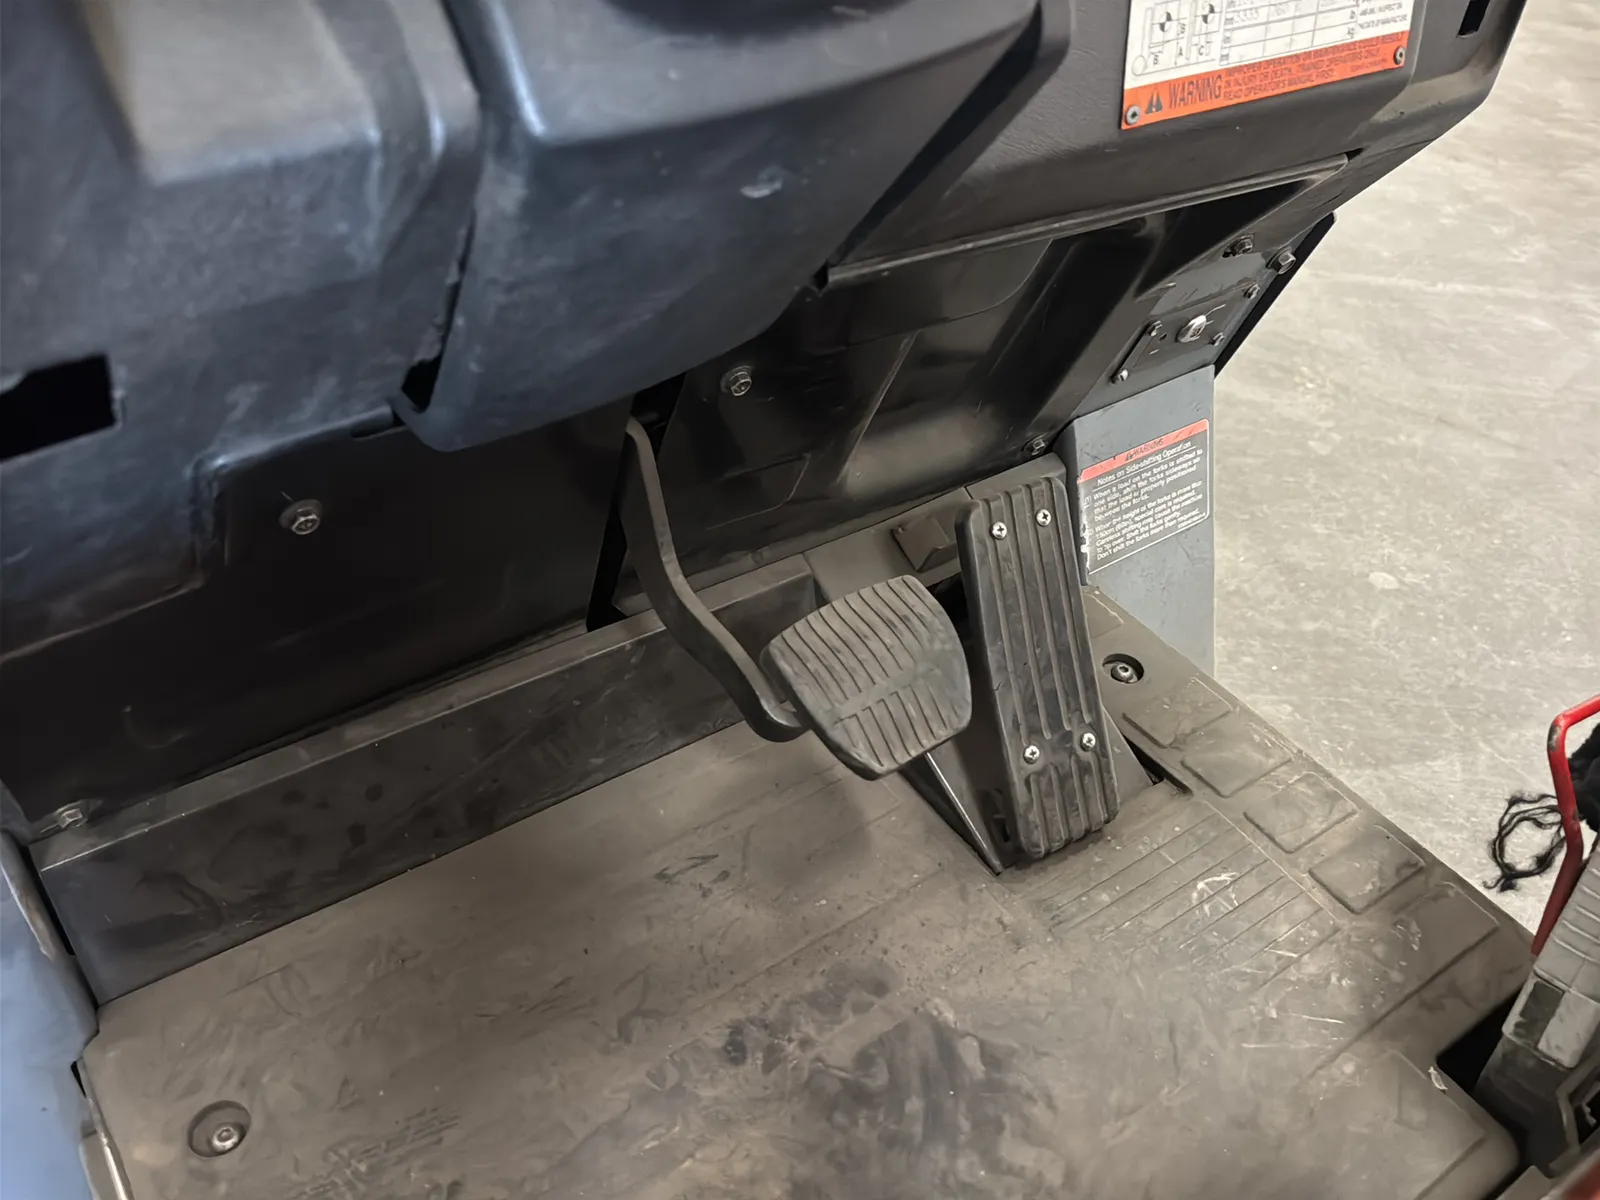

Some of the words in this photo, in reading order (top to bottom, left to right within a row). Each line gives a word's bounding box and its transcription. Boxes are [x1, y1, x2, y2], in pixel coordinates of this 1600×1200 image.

[1233, 73, 1257, 88] INJURY
[1259, 71, 1269, 81] OR
[1263, 54, 1301, 71] OPERATION
[1168, 75, 1222, 110] WARNING
[1223, 89, 1243, 102] READ
[1097, 474, 1115, 487] Notes
[1116, 470, 1125, 478] on
[1125, 453, 1162, 474] Side-shifting
[1162, 441, 1191, 458] Operation
[1131, 438, 1164, 457] WARNING
[1093, 489, 1111, 501] When
[1118, 478, 1131, 490] load
[1132, 475, 1141, 484] on
[1141, 471, 1151, 480] the
[1152, 464, 1168, 474] forks
[1176, 450, 1196, 465] shifted
[1094, 499, 1105, 507] one
[1123, 484, 1137, 496] shift
[1137, 479, 1148, 488] the
[1149, 472, 1164, 482] forks
[1165, 459, 1192, 476] sideways
[1192, 457, 1201, 465] so
[1094, 505, 1107, 515] that
[1107, 500, 1118, 509] the
[1119, 492, 1132, 504] load
[1140, 480, 1165, 497] properly
[1166, 465, 1196, 484] positioned
[1112, 516, 1121, 525] the
[1122, 508, 1140, 520] height
[1147, 500, 1157, 509] the
[1157, 494, 1171, 504] forks
[1177, 485, 1191, 495] more
[1121, 501, 1131, 510] the
[1134, 508, 1154, 521] special
[1154, 503, 1167, 513] care
[1096, 531, 1121, 547] Careless
[1121, 522, 1142, 536] shifting
[1154, 508, 1171, 520] cause
[1171, 504, 1181, 512] the
[1097, 549, 1112, 561] Don't
[1112, 542, 1126, 553] shift
[1126, 539, 1136, 547] the
[1135, 532, 1150, 542] forks
[1150, 525, 1164, 536] more
[1164, 519, 1178, 529] than
[1126, 528, 1139, 540] Shift
[1139, 525, 1150, 534] the
[1150, 518, 1163, 528] forks
